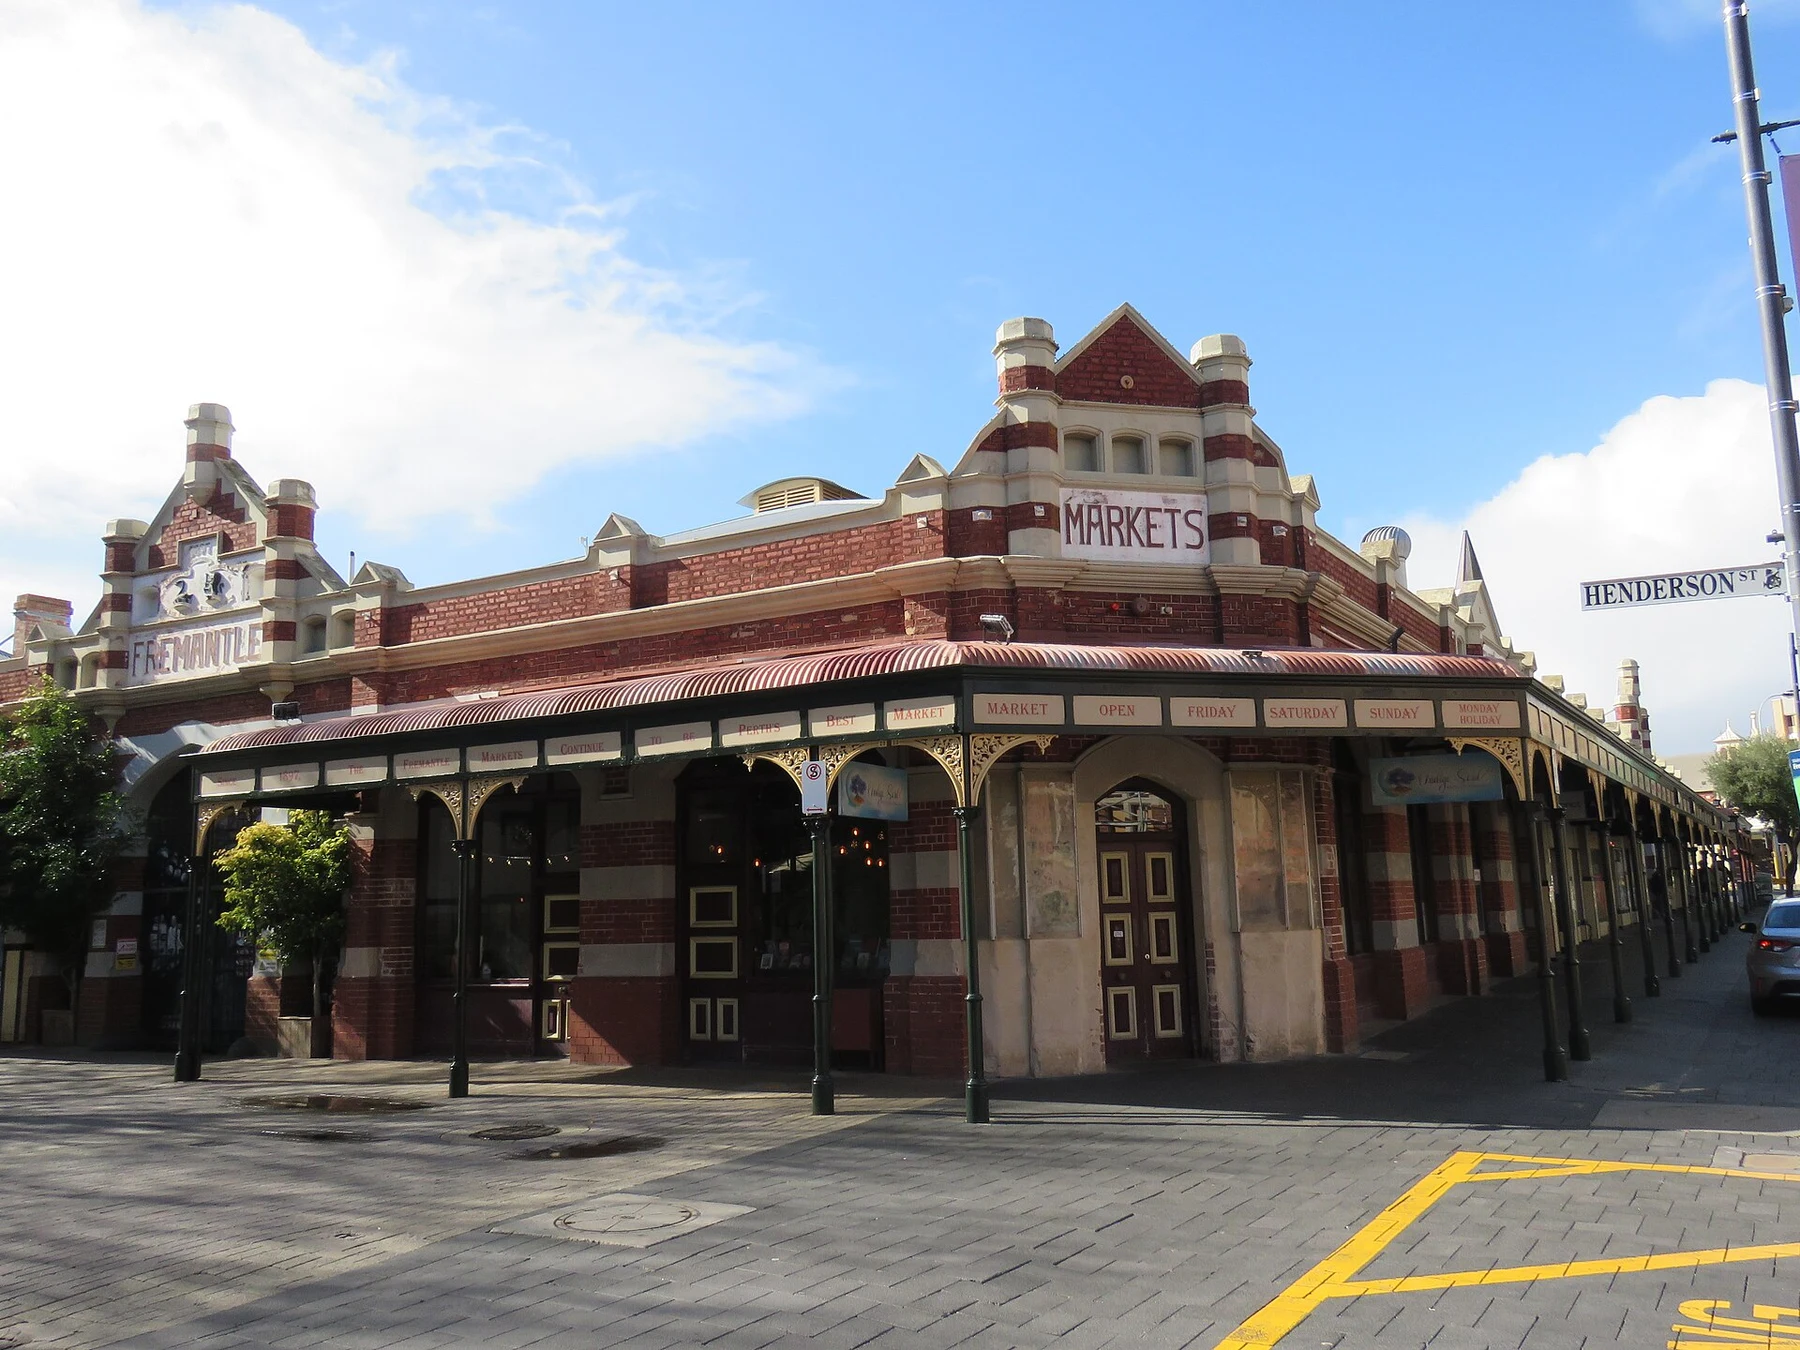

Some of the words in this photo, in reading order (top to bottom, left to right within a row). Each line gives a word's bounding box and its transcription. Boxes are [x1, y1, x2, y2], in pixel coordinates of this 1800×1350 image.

[1065, 503, 1204, 550] MARKETS
[1584, 571, 1735, 607] HENDERSON
[1739, 569, 1758, 582] ST
[132, 622, 262, 676] FREMANTLE
[987, 702, 1049, 715] MARKET
[1099, 704, 1136, 717] OPEN
[1188, 705, 1237, 718] FRIDAY
[1269, 705, 1340, 719] SATURDAY
[1369, 706, 1421, 720] SUNDAY
[1458, 703, 1501, 714] MONDAY
[1459, 714, 1503, 725] HOLIDAY
[403, 757, 450, 769] FREMANTLE
[481, 750, 524, 763] MARKETS
[560, 741, 604, 755] CONTINUE
[739, 722, 781, 736] PERTH'S
[826, 714, 857, 727] BEST
[893, 707, 945, 720] MARKET
